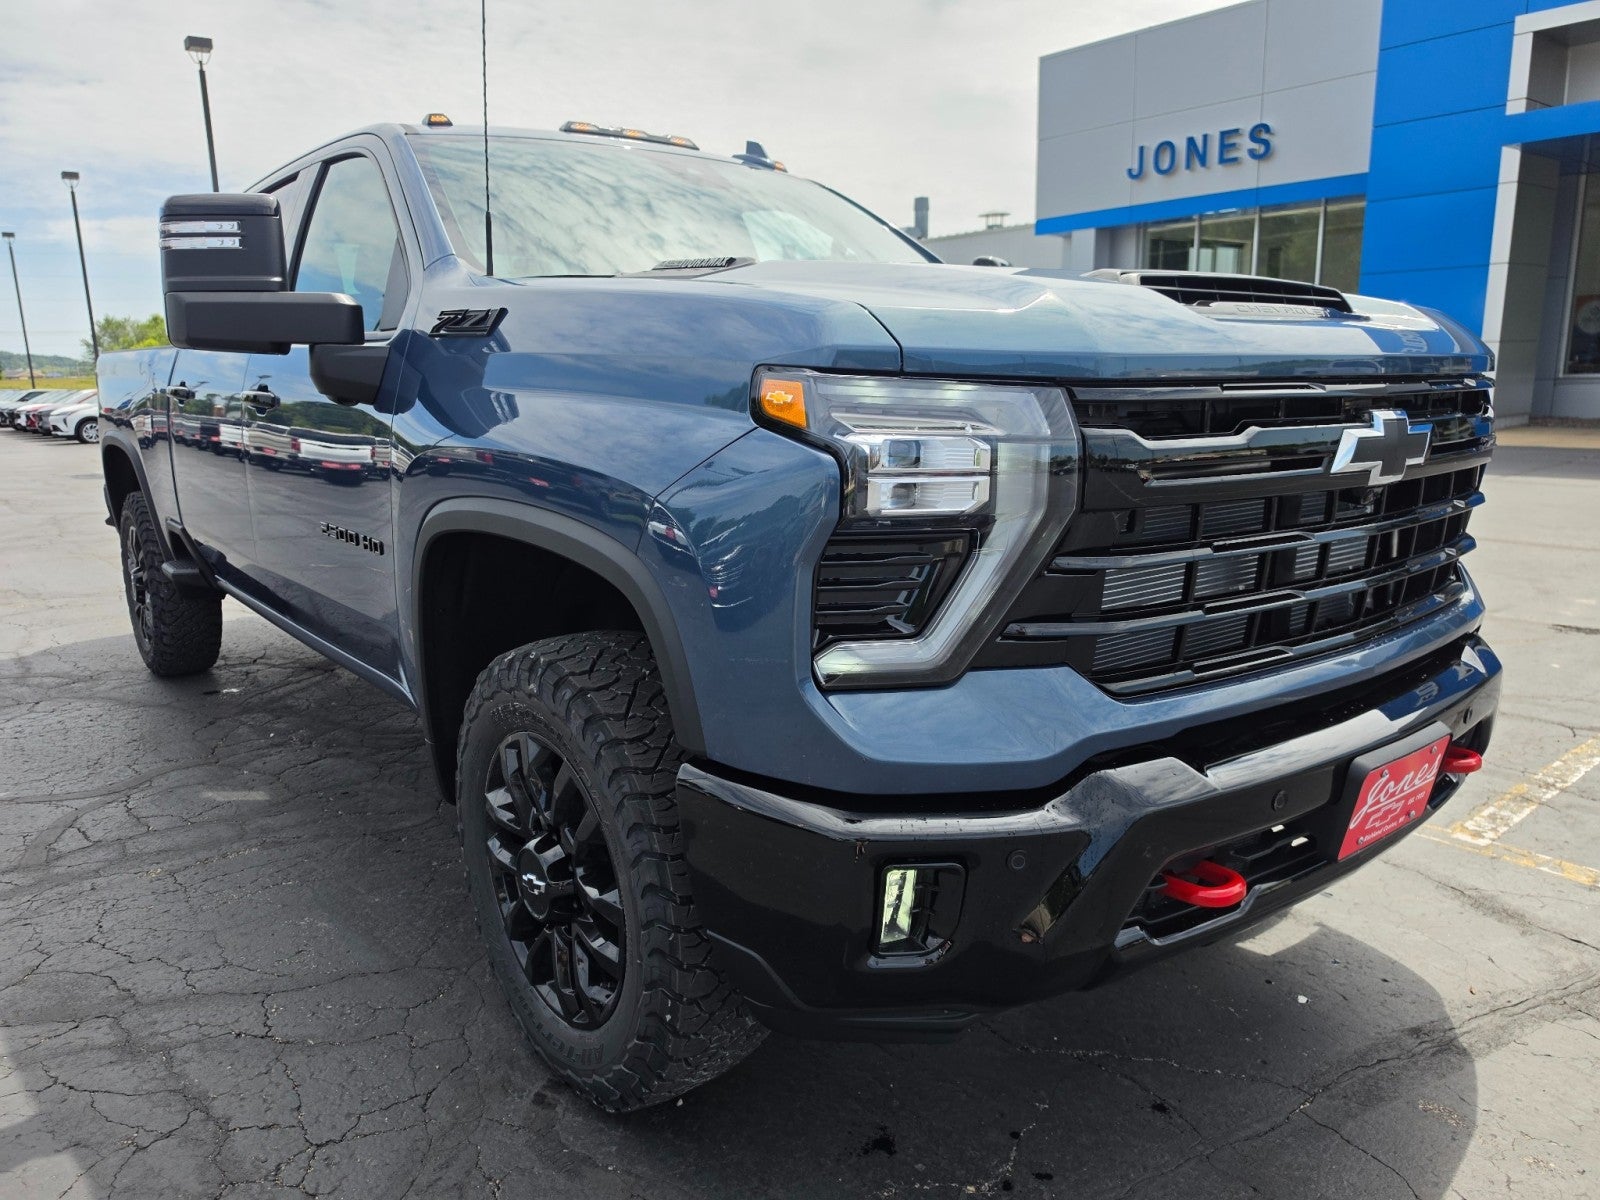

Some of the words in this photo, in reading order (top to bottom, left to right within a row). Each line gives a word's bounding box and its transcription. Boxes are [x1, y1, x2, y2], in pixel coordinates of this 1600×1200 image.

[1127, 123, 1272, 180] JONES
[428, 307, 509, 337] Z71
[1233, 304, 1331, 318] CHEVROLET
[362, 534, 385, 556] HD
[1349, 753, 1442, 830] Jones
